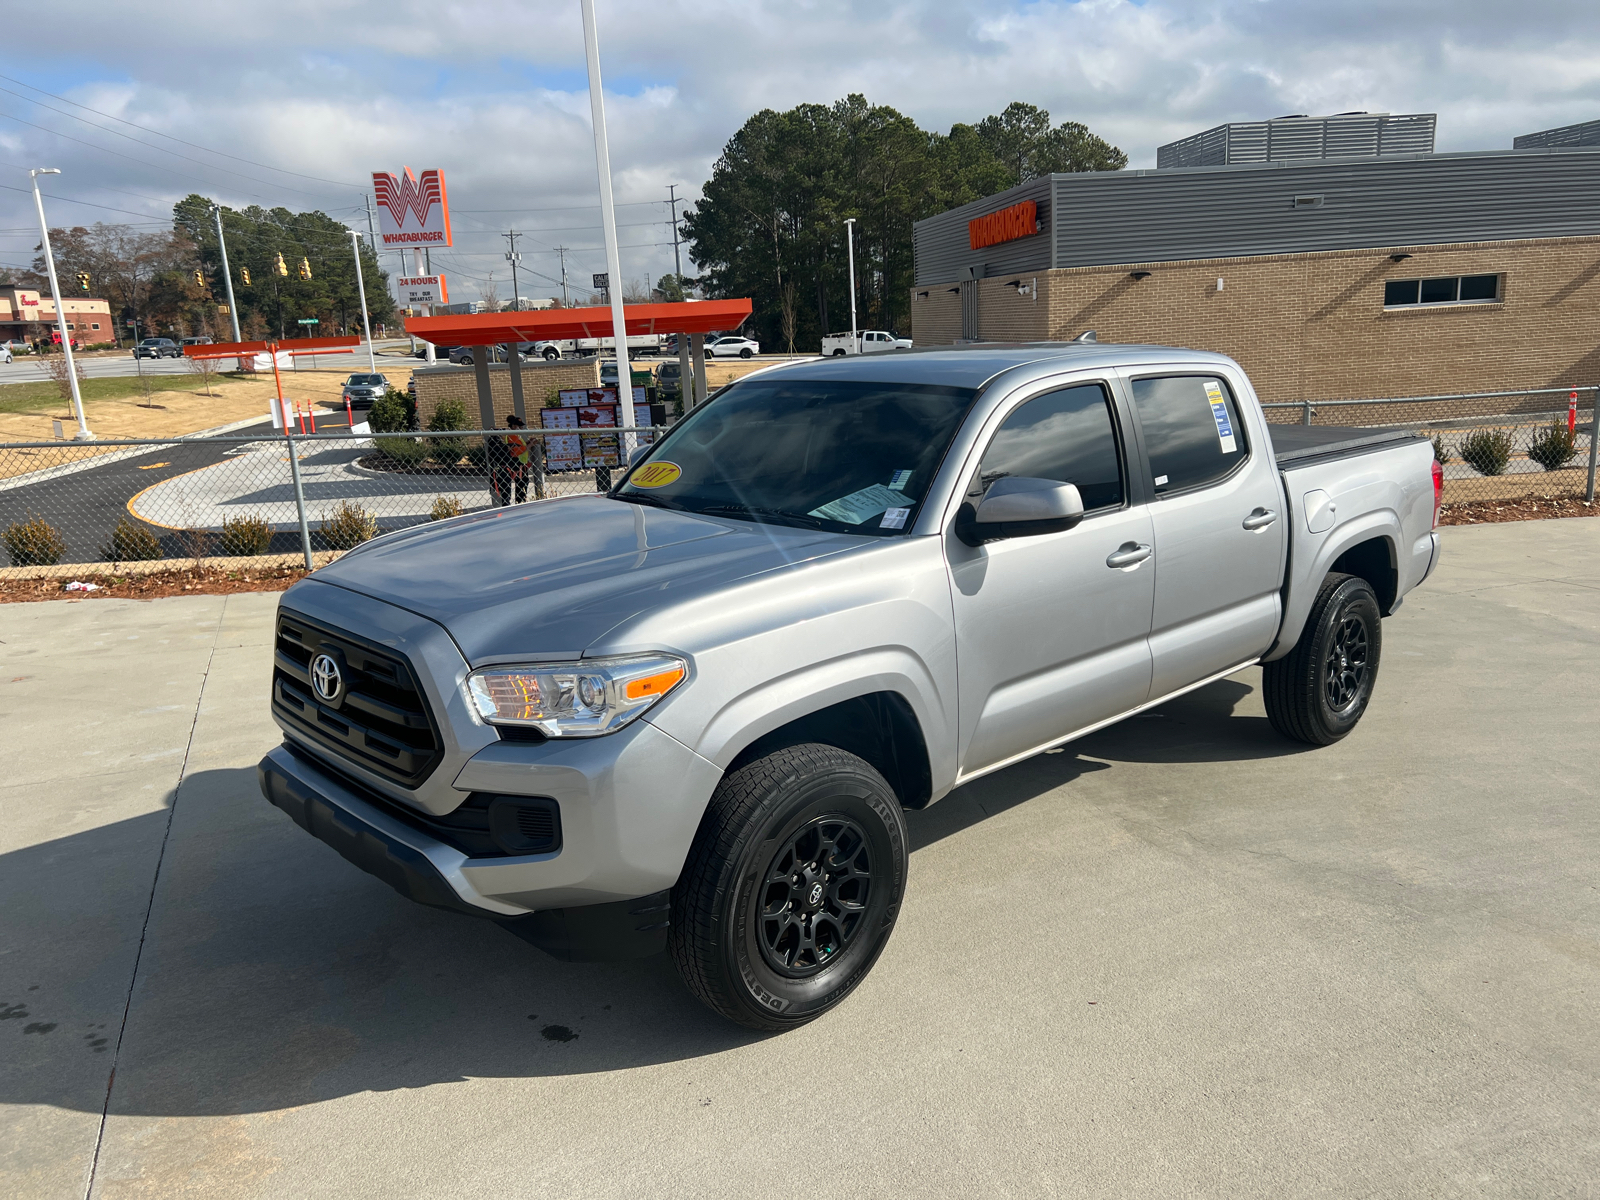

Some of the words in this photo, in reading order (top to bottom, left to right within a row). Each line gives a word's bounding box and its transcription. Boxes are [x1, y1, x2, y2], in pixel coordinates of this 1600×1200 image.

[968, 199, 1036, 250] WHATABURGER
[382, 231, 444, 244] WHATABURGER
[399, 278, 409, 286] 24
[410, 276, 439, 286] HOURS
[633, 465, 677, 483] 2017
[871, 797, 903, 900] Firestone
